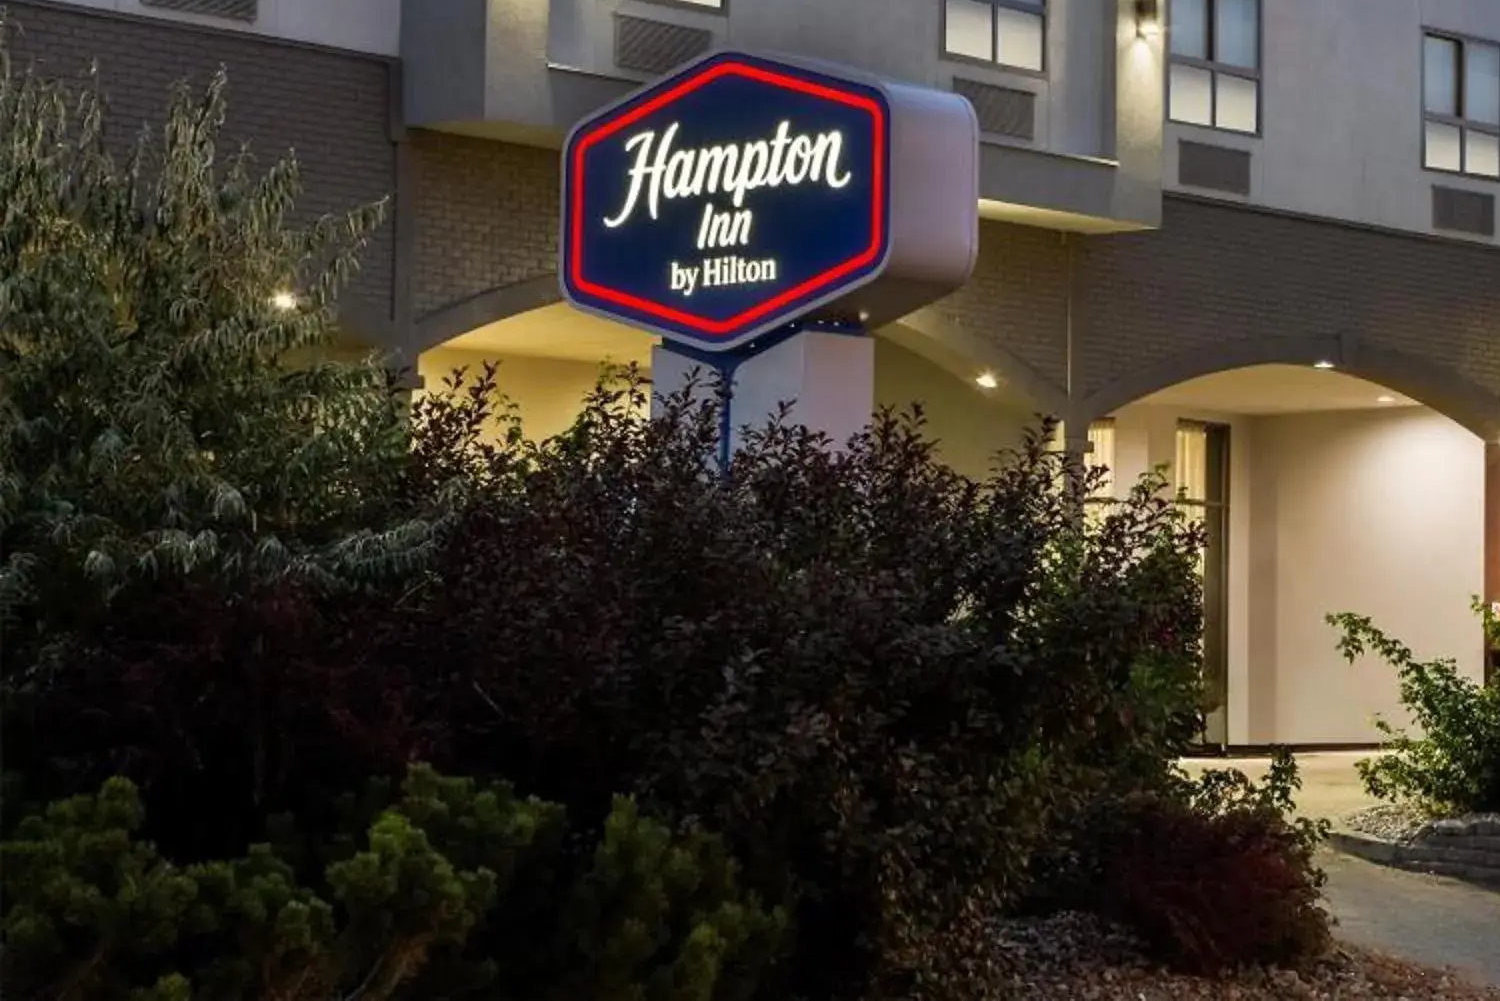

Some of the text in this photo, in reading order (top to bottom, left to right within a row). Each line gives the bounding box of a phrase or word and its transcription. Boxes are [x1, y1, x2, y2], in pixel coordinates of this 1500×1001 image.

[603, 120, 851, 228] Hampton
[697, 203, 752, 250] Inn
[670, 256, 777, 296] by Hilton
